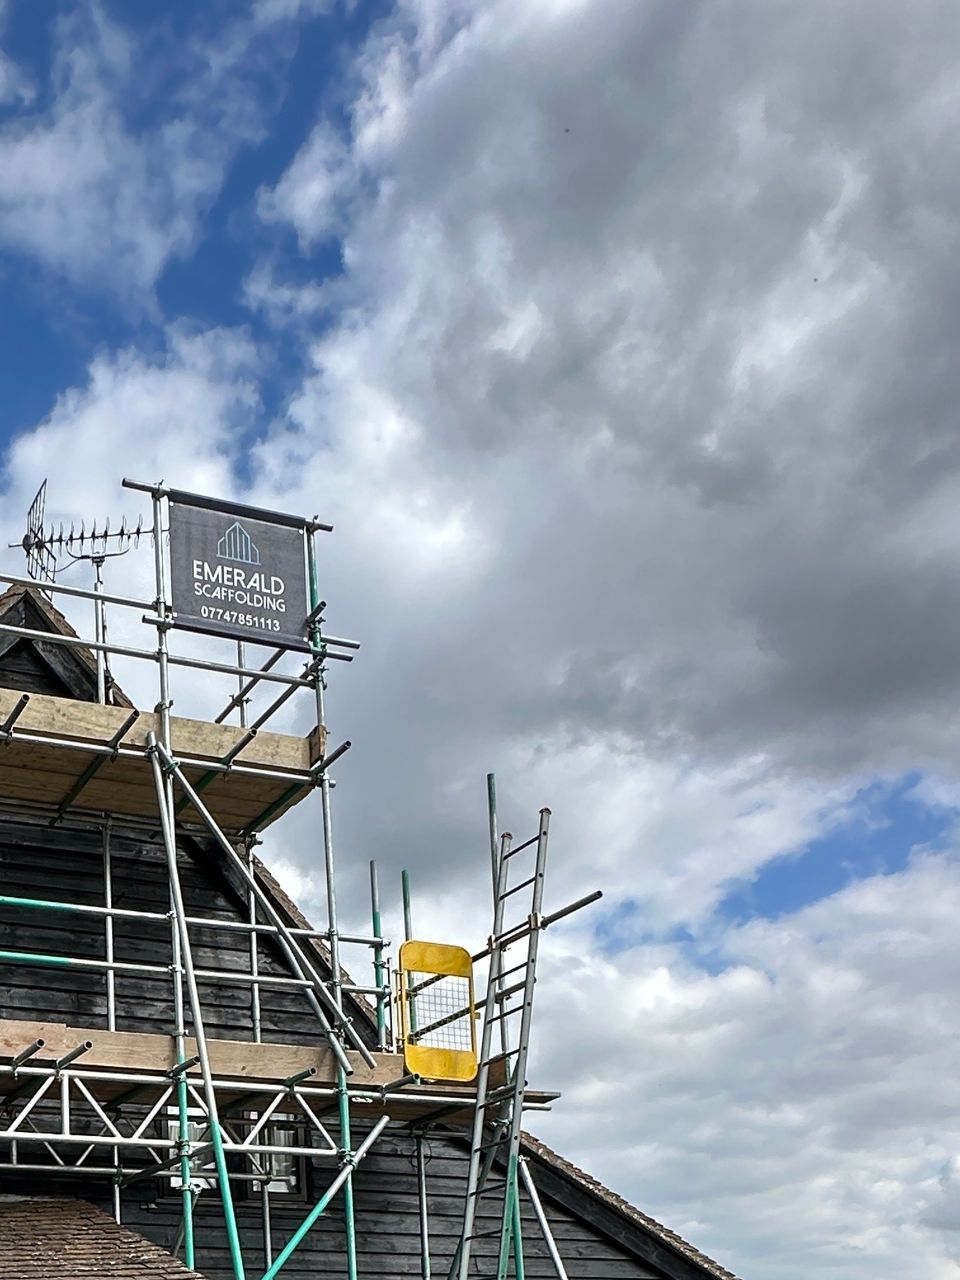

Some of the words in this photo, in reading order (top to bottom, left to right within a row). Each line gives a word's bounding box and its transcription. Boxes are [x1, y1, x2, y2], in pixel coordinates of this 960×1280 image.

[193, 560, 285, 596] EMERALD
[194, 582, 286, 613] SCAFFOLDING
[201, 605, 281, 632] 07747851113
